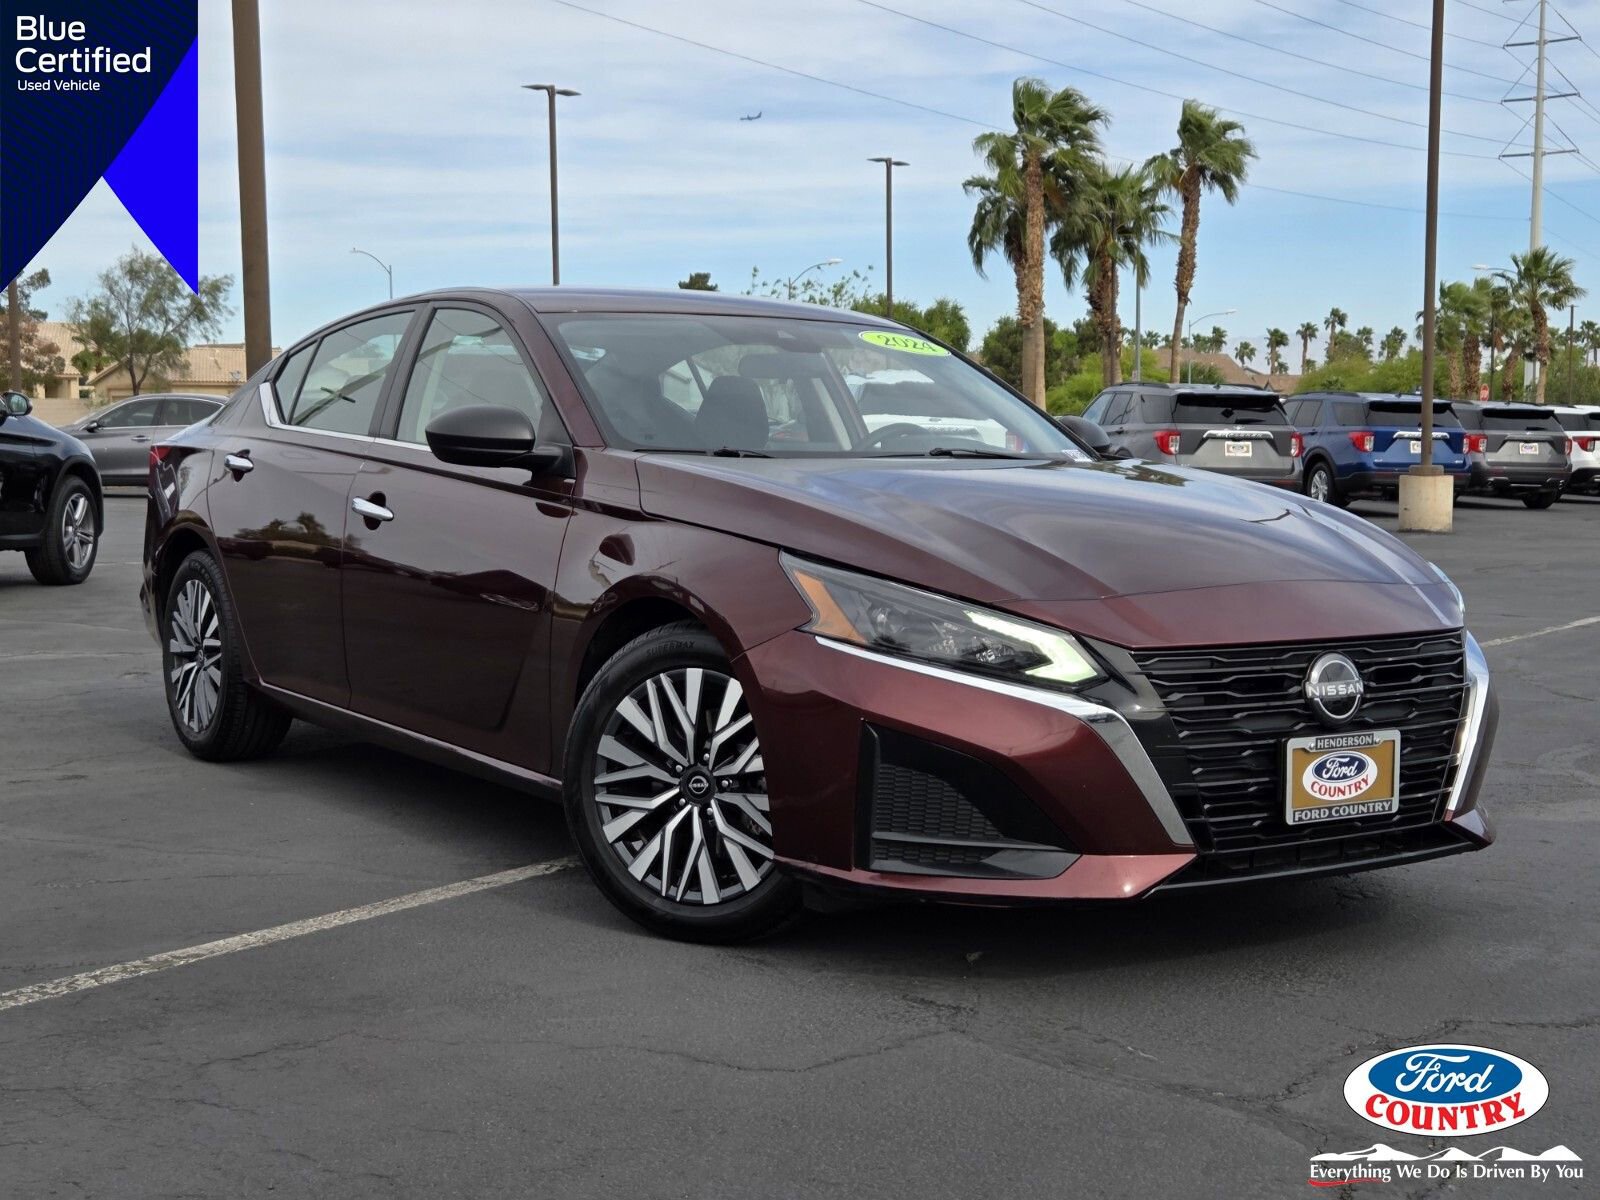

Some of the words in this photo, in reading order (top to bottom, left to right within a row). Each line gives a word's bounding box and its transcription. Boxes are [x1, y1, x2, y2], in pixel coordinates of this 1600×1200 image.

[1305, 681, 1364, 697] NISSAN
[1317, 734, 1373, 749] HENDERSON
[1321, 756, 1358, 779] Ford
[1310, 774, 1370, 798] COUNTRY
[1294, 808, 1330, 823] FORD
[1331, 800, 1392, 818] COUNTRY
